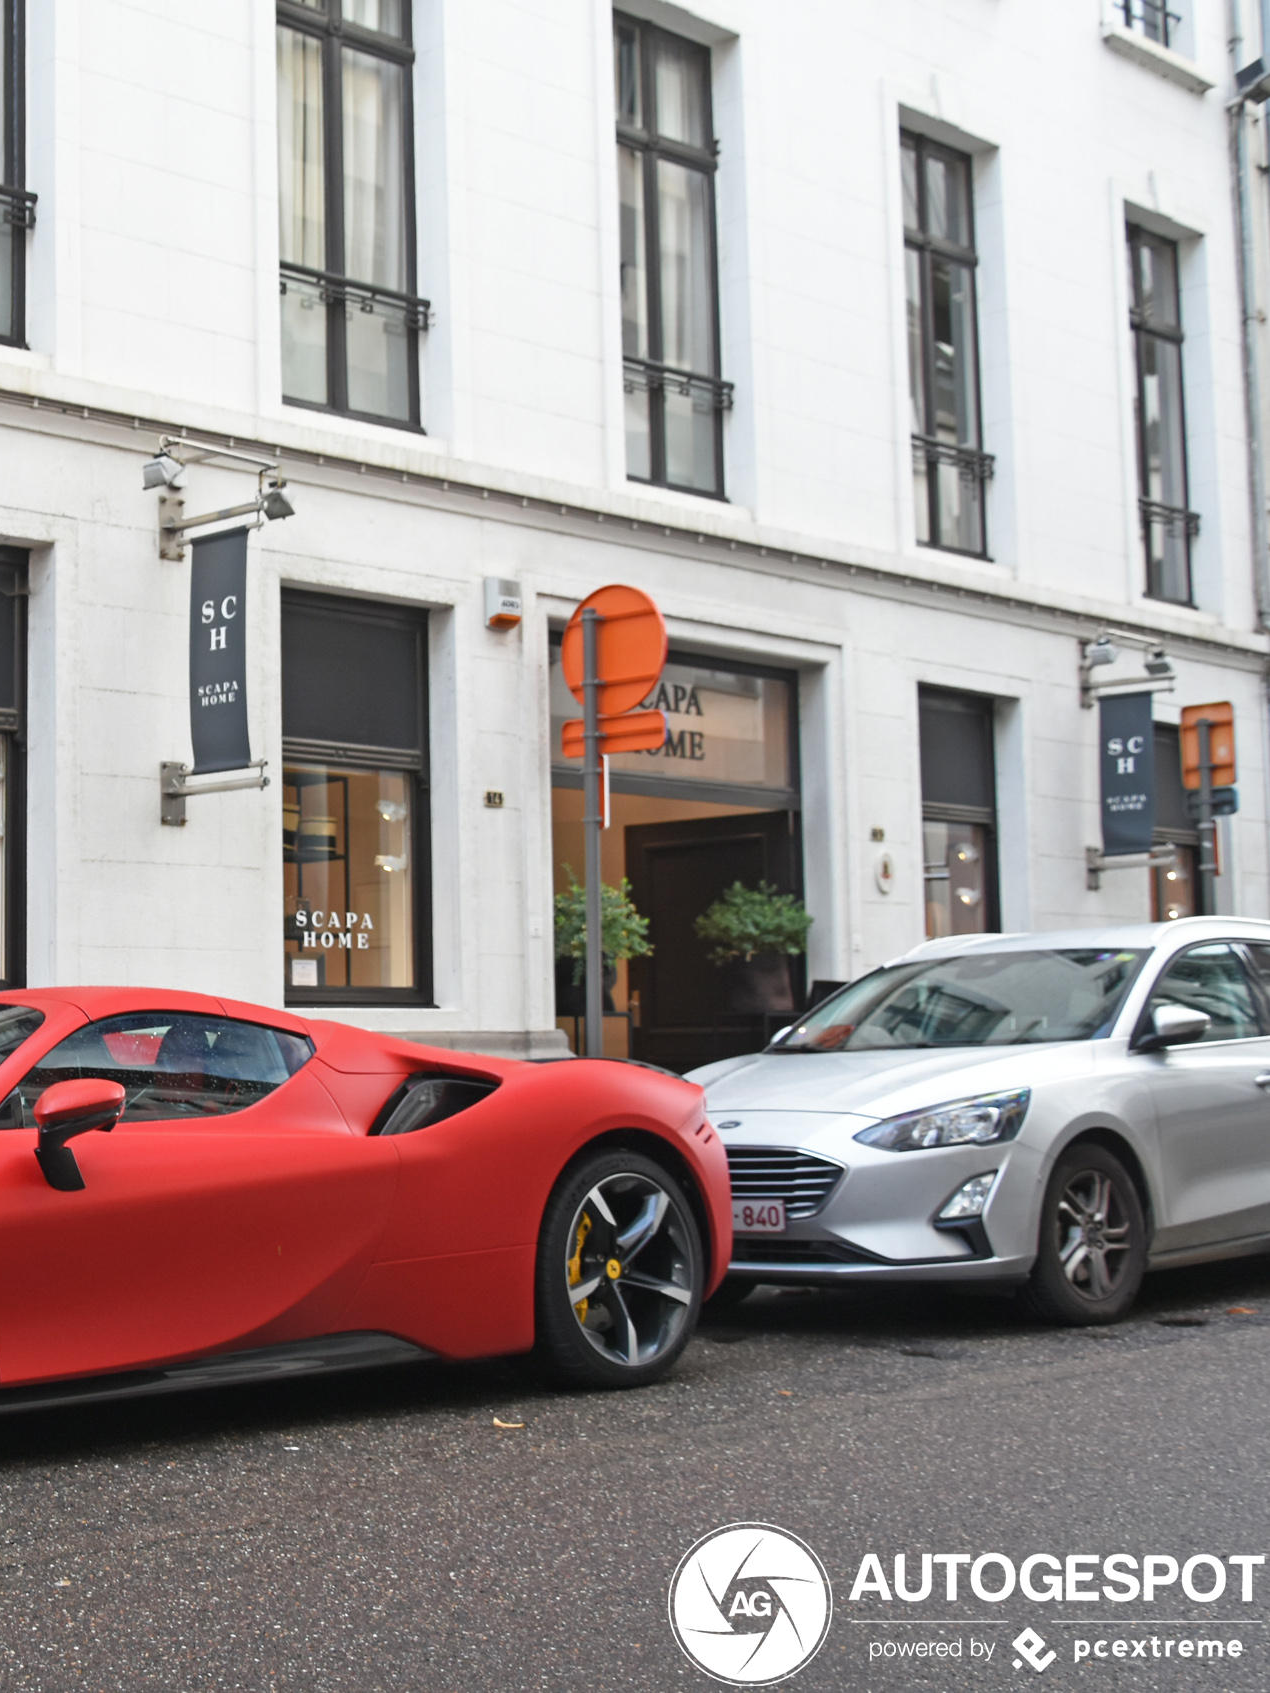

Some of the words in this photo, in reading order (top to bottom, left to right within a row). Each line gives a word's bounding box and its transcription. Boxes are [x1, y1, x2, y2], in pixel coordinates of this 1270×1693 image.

[209, 626, 228, 651] H
[197, 680, 239, 697] SCAPA
[201, 691, 236, 707] HOME
[638, 682, 704, 716] APA
[1116, 757, 1135, 774] H
[295, 910, 374, 930] SCAPA
[303, 931, 370, 950] HOME
